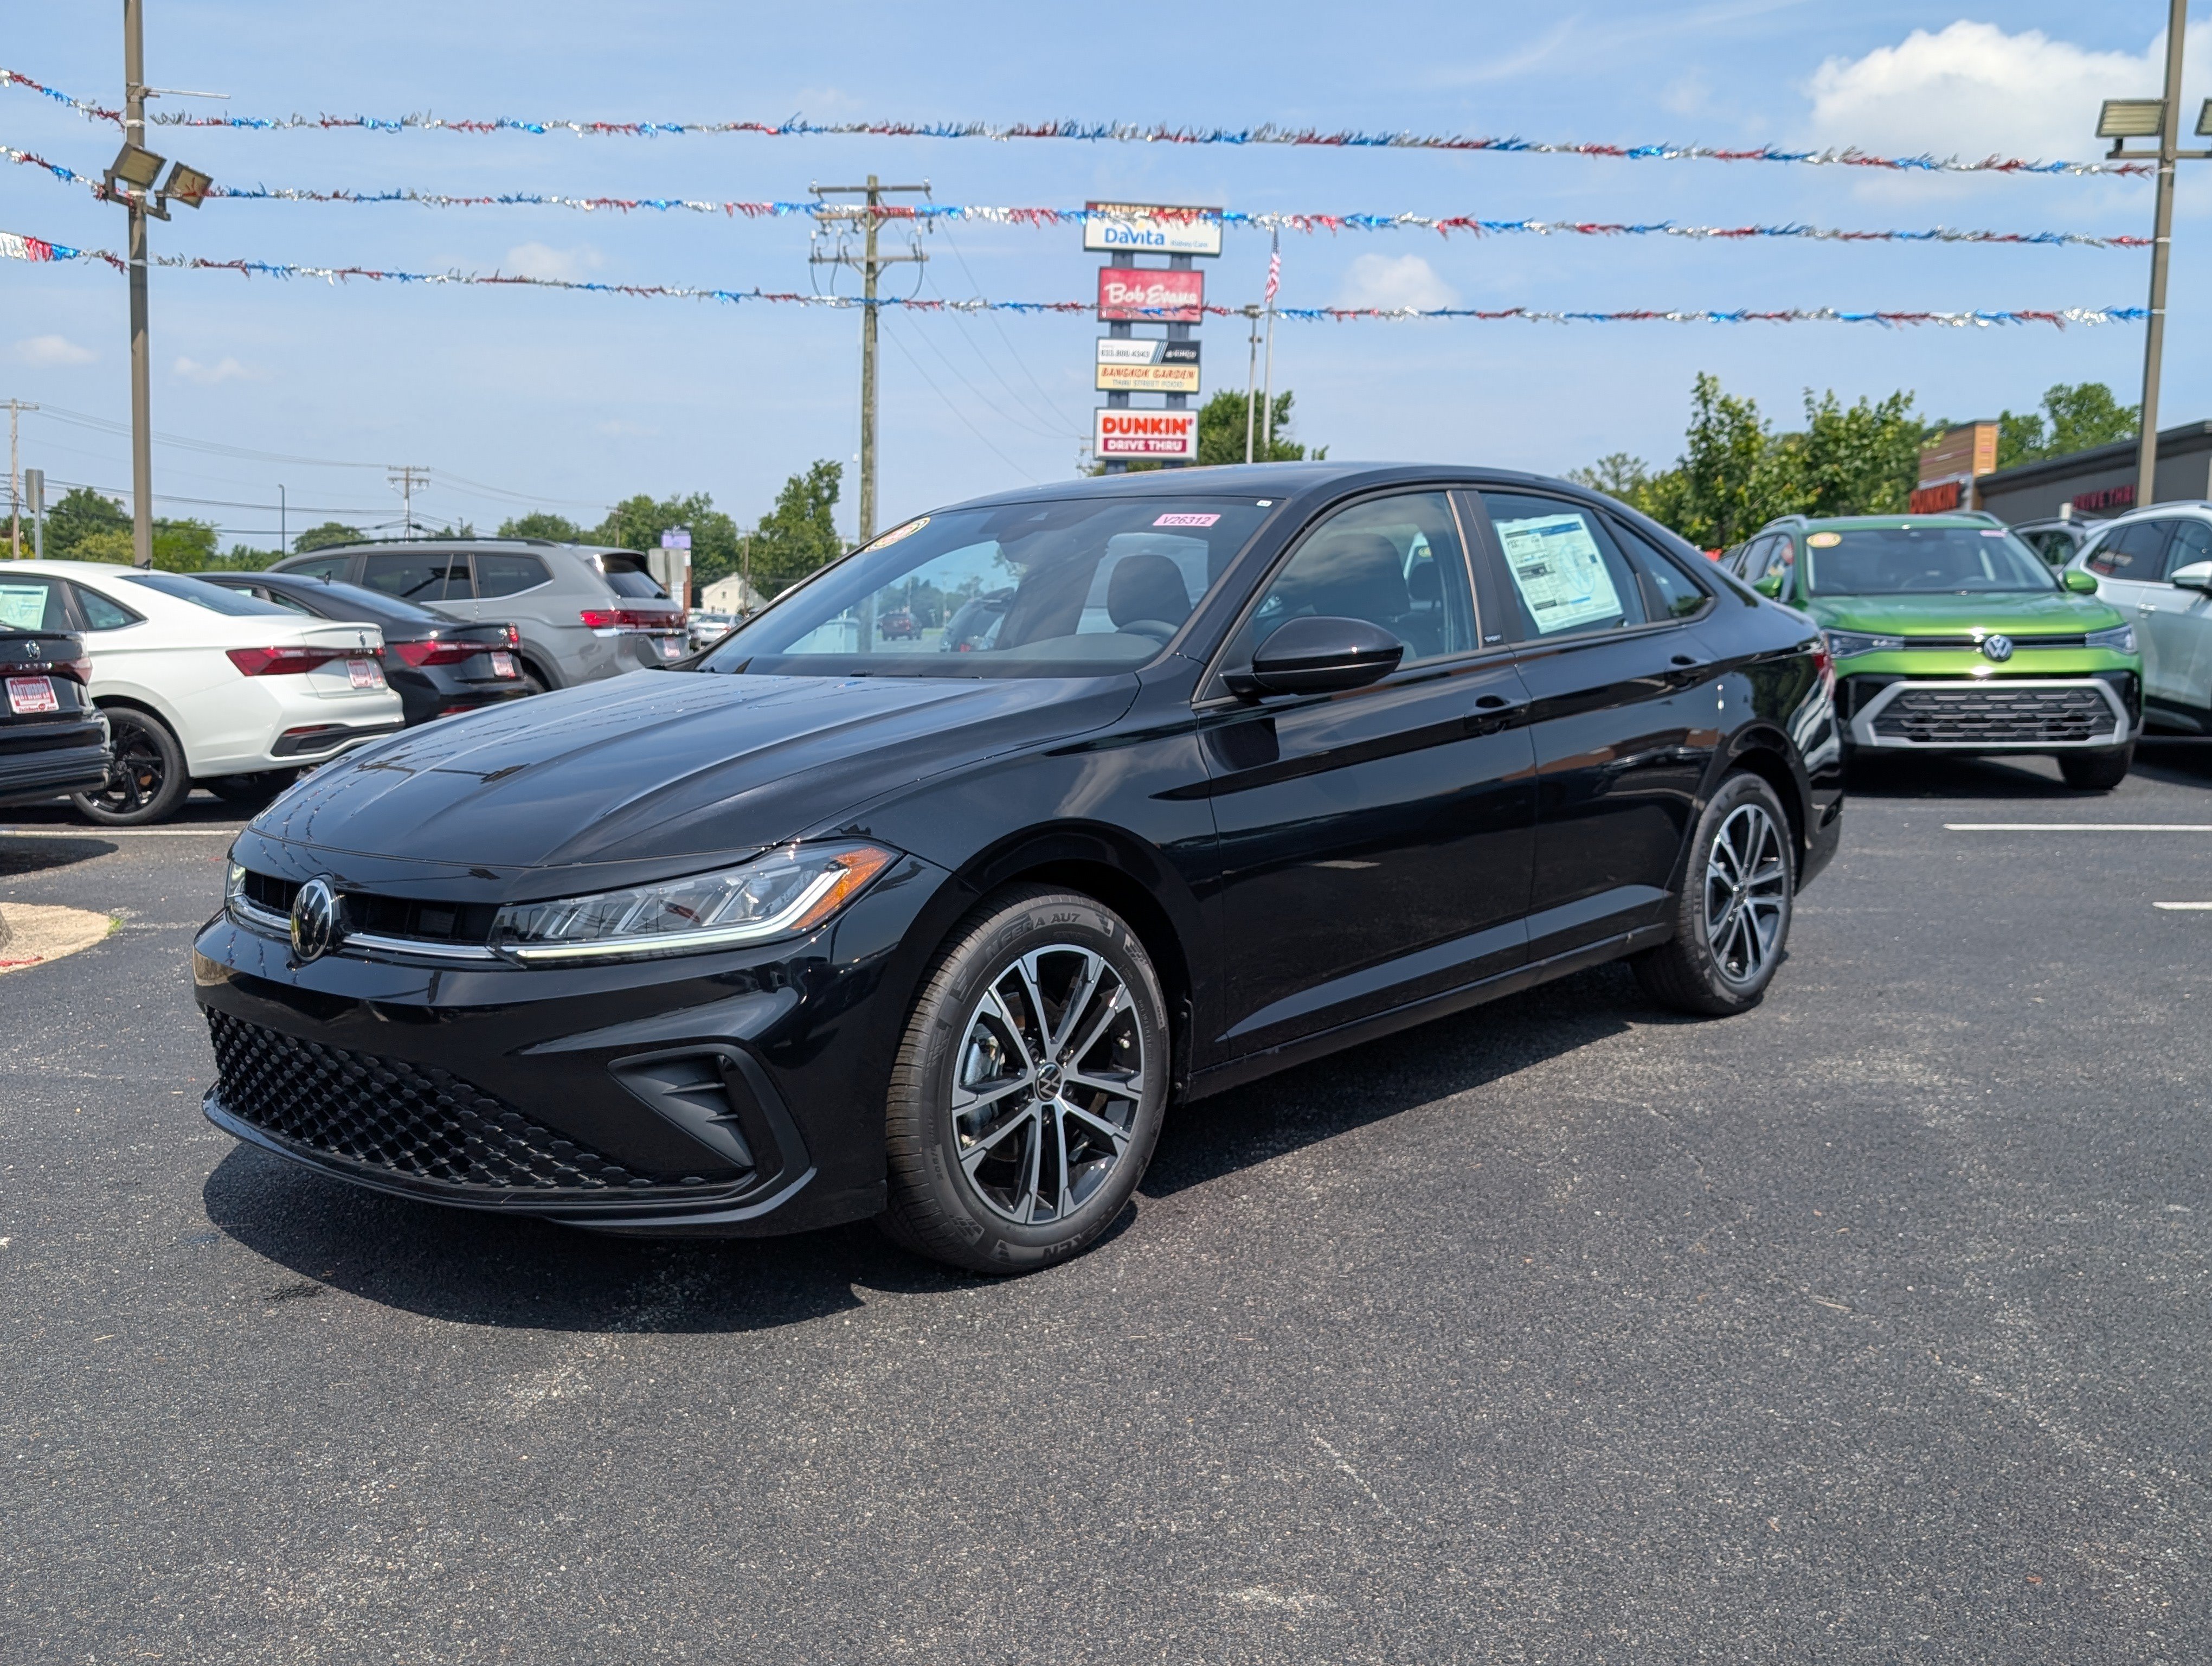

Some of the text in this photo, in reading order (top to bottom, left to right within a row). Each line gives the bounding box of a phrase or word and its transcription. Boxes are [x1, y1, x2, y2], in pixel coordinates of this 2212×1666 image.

[1105, 223, 1165, 246] DaVita
[1104, 283, 1197, 304] Bob Evans
[1101, 367, 1195, 380] BANGKOK GARDEN
[1102, 417, 1194, 434] DUNKIN'
[1107, 440, 1183, 451] DRIVE THRU
[1163, 516, 1211, 524] V26312
[1050, 912, 1081, 923] AU7
